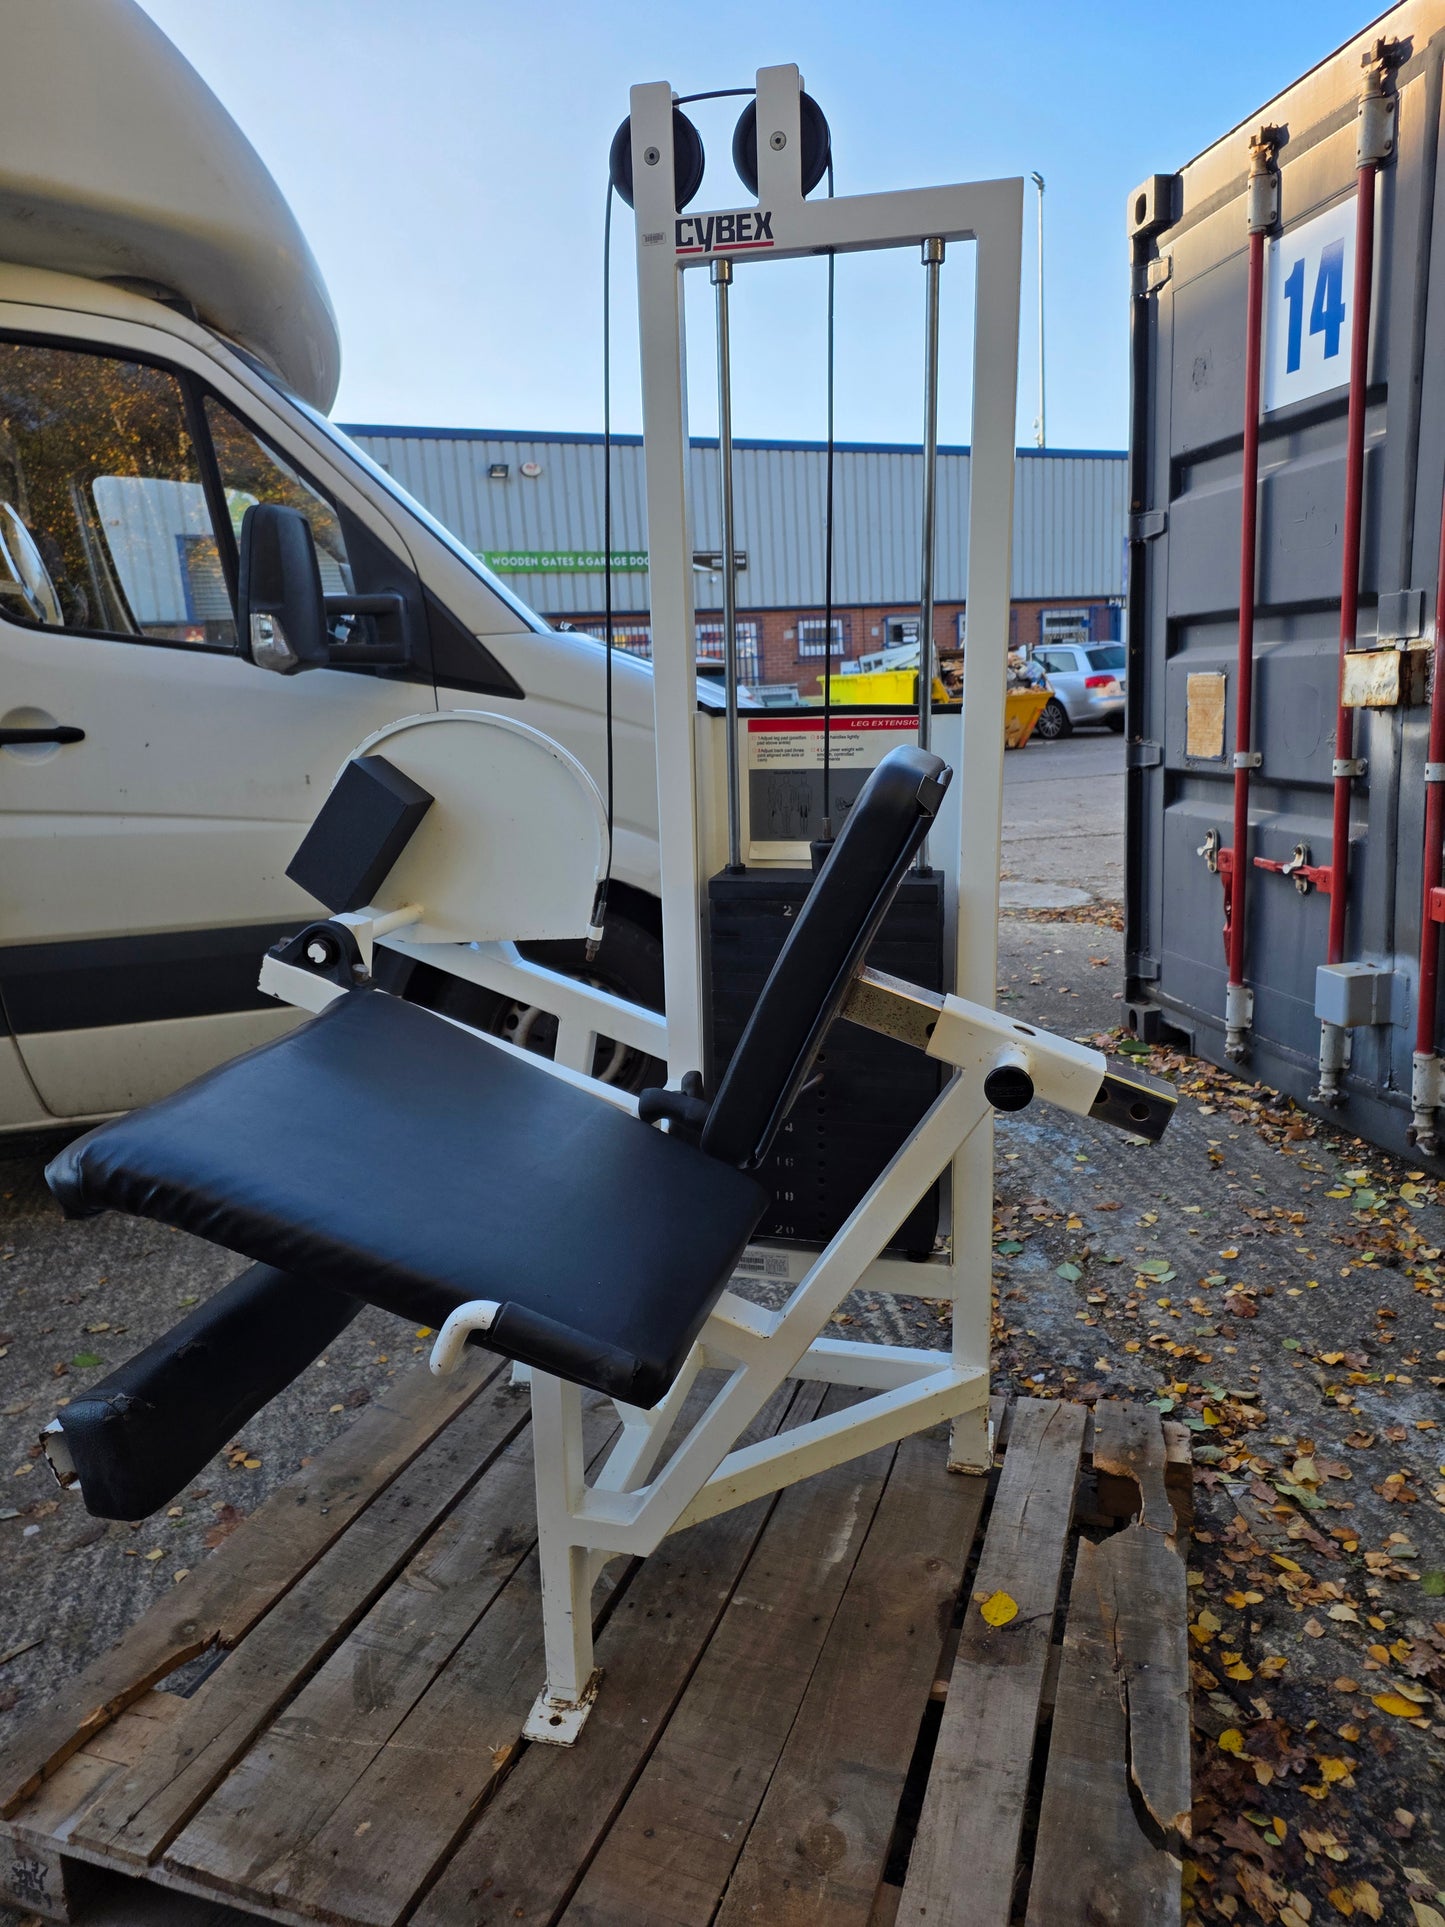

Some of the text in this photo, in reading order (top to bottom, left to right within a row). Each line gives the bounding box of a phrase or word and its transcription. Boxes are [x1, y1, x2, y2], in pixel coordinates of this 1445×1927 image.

[675, 211, 774, 253] CYBEX
[1284, 237, 1346, 374] 14
[491, 555, 539, 567] WOODEN
[542, 556, 574, 567] GATES
[577, 556, 585, 567] &
[630, 555, 650, 567] DOO
[871, 719, 919, 727] EXTENSIO
[783, 905, 792, 917] 2
